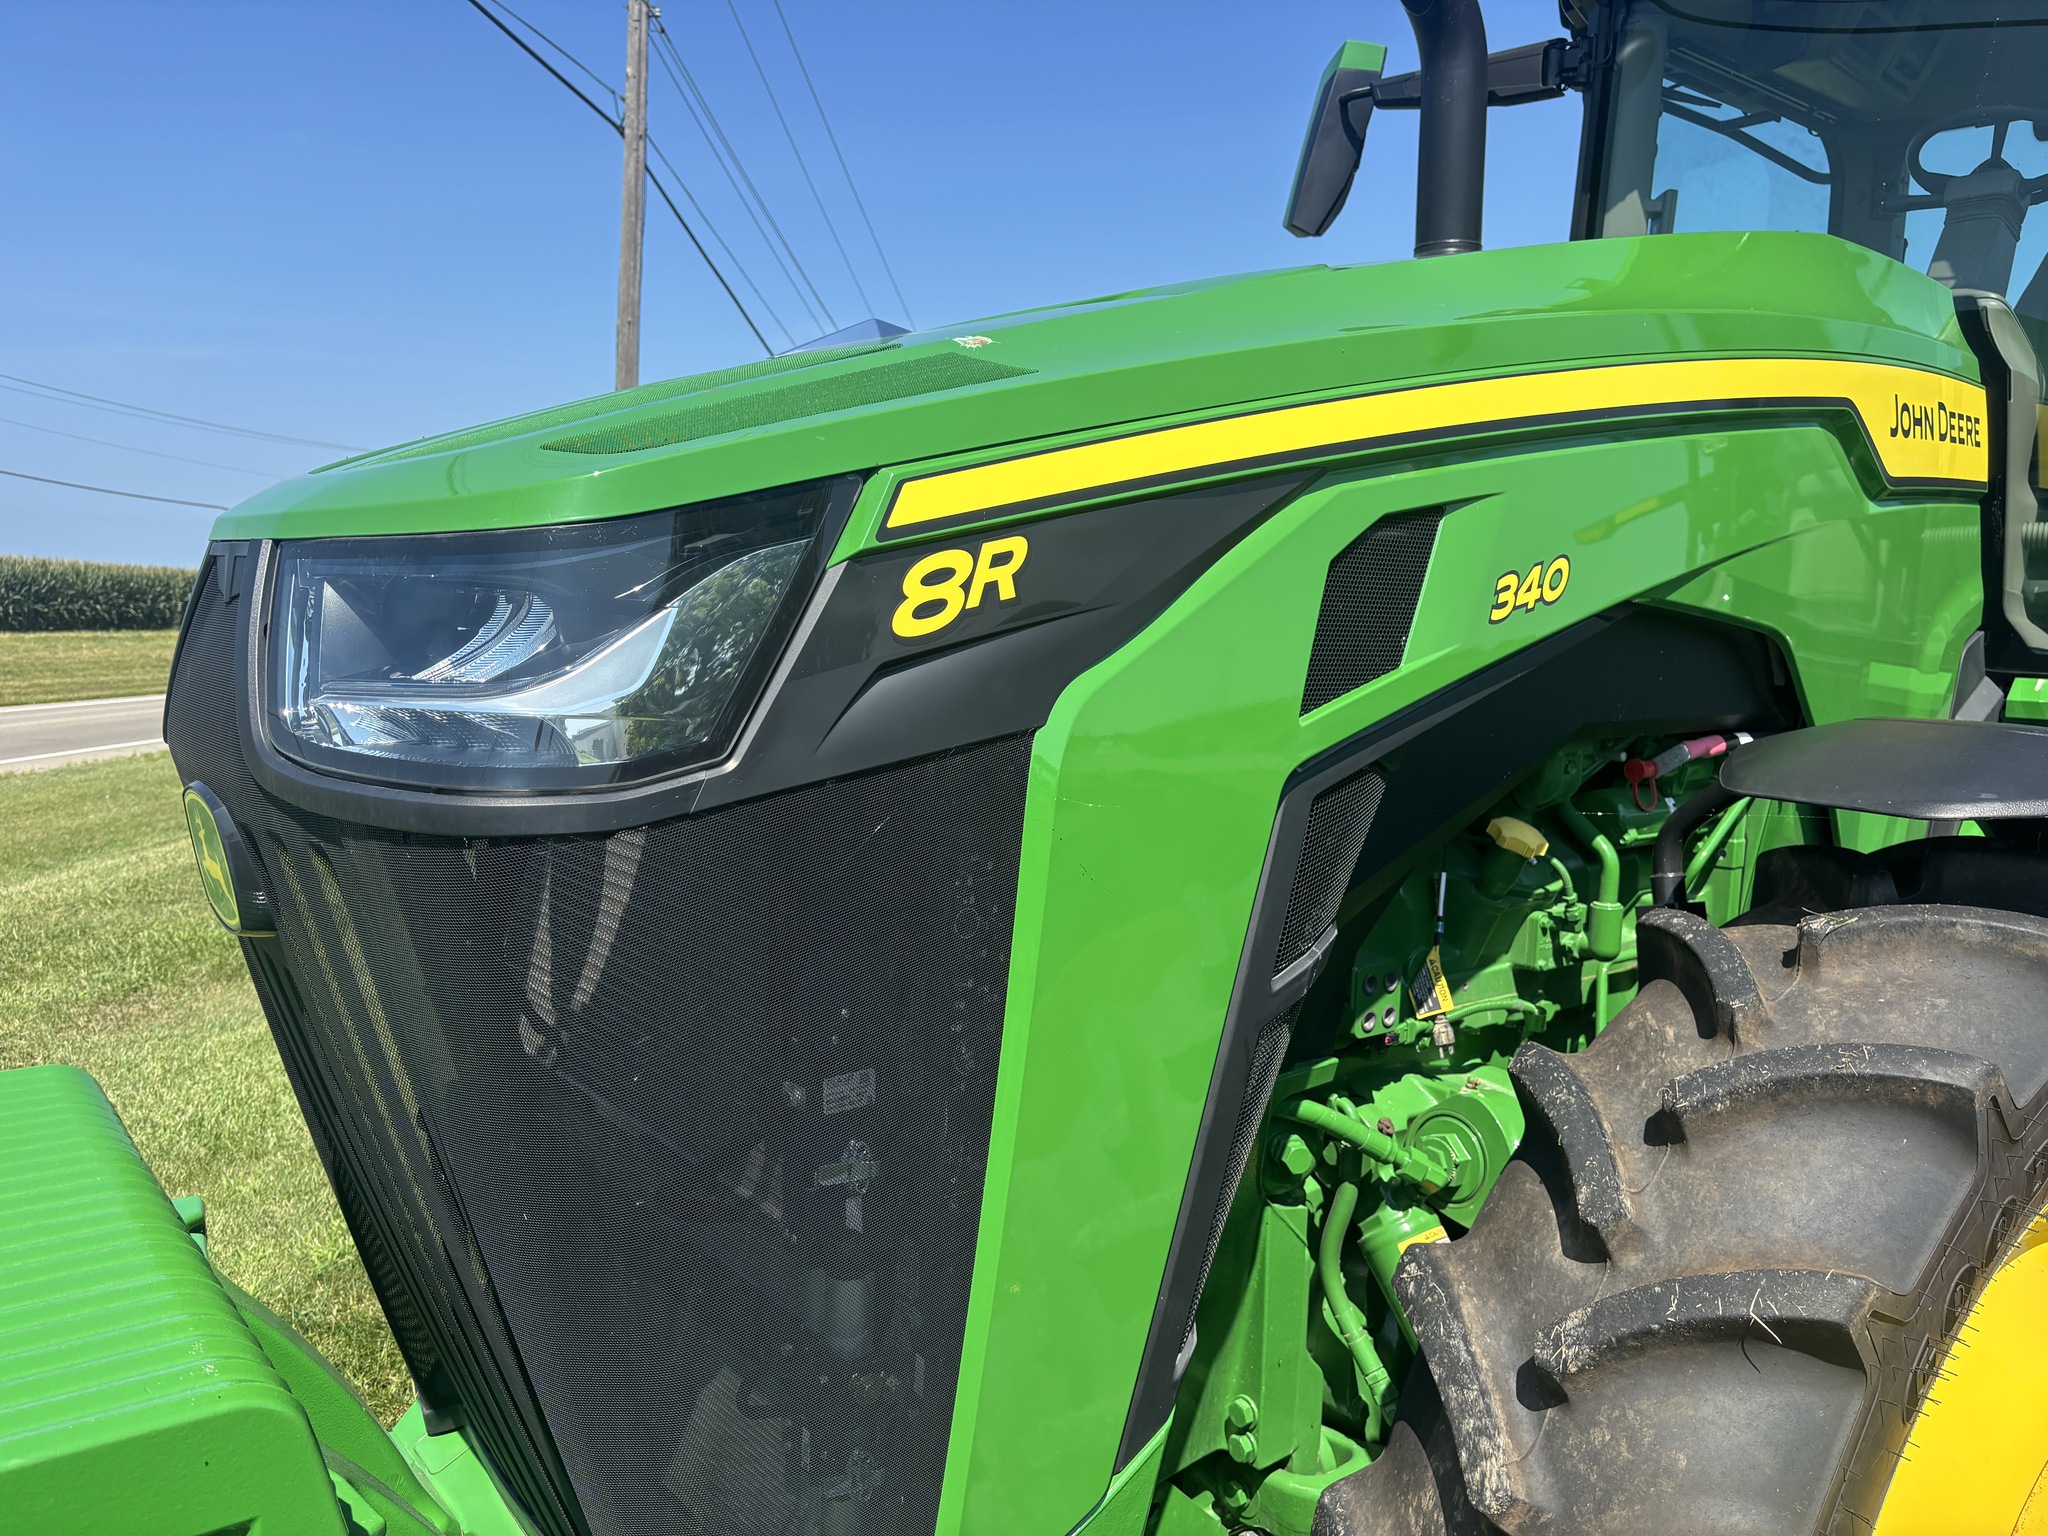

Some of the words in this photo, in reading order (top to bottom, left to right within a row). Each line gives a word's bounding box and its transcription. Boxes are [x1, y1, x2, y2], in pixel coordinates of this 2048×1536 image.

[1889, 393, 1935, 442] JOHN
[1937, 400, 1982, 449] DEERE
[891, 535, 1029, 638] 8R
[1488, 554, 1571, 624] 340
[1430, 964, 1449, 1002] CAUTION
